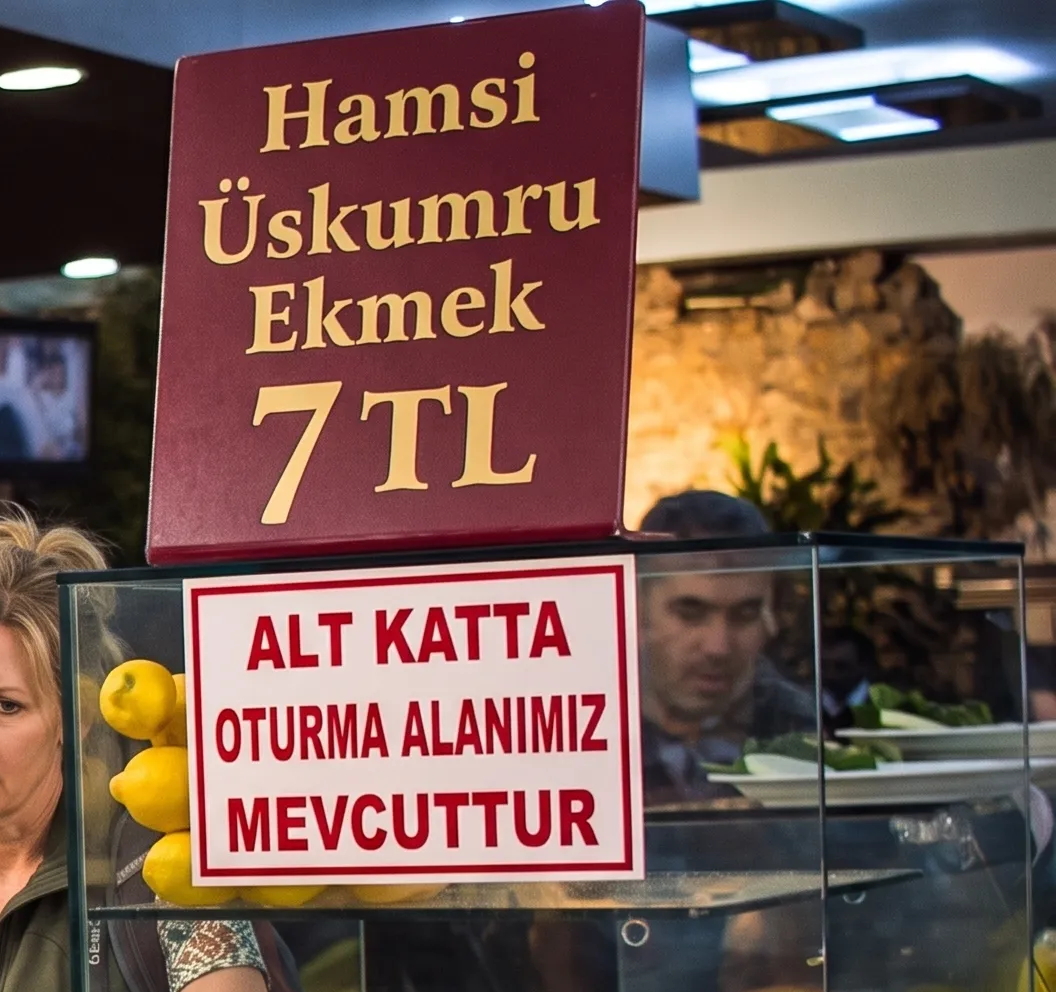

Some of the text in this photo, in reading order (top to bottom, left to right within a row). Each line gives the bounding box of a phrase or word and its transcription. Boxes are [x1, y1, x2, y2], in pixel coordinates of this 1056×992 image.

[260, 51, 540, 153] Hamsi
[198, 176, 601, 265] Üskumru
[245, 258, 546, 355] Ekmek
[252, 380, 537, 525] 7 TL
[247, 601, 571, 671] ALT KATTA
[215, 693, 608, 763] OTURMA ALANIMIZ
[228, 789, 599, 853] MEVCUTTUR
